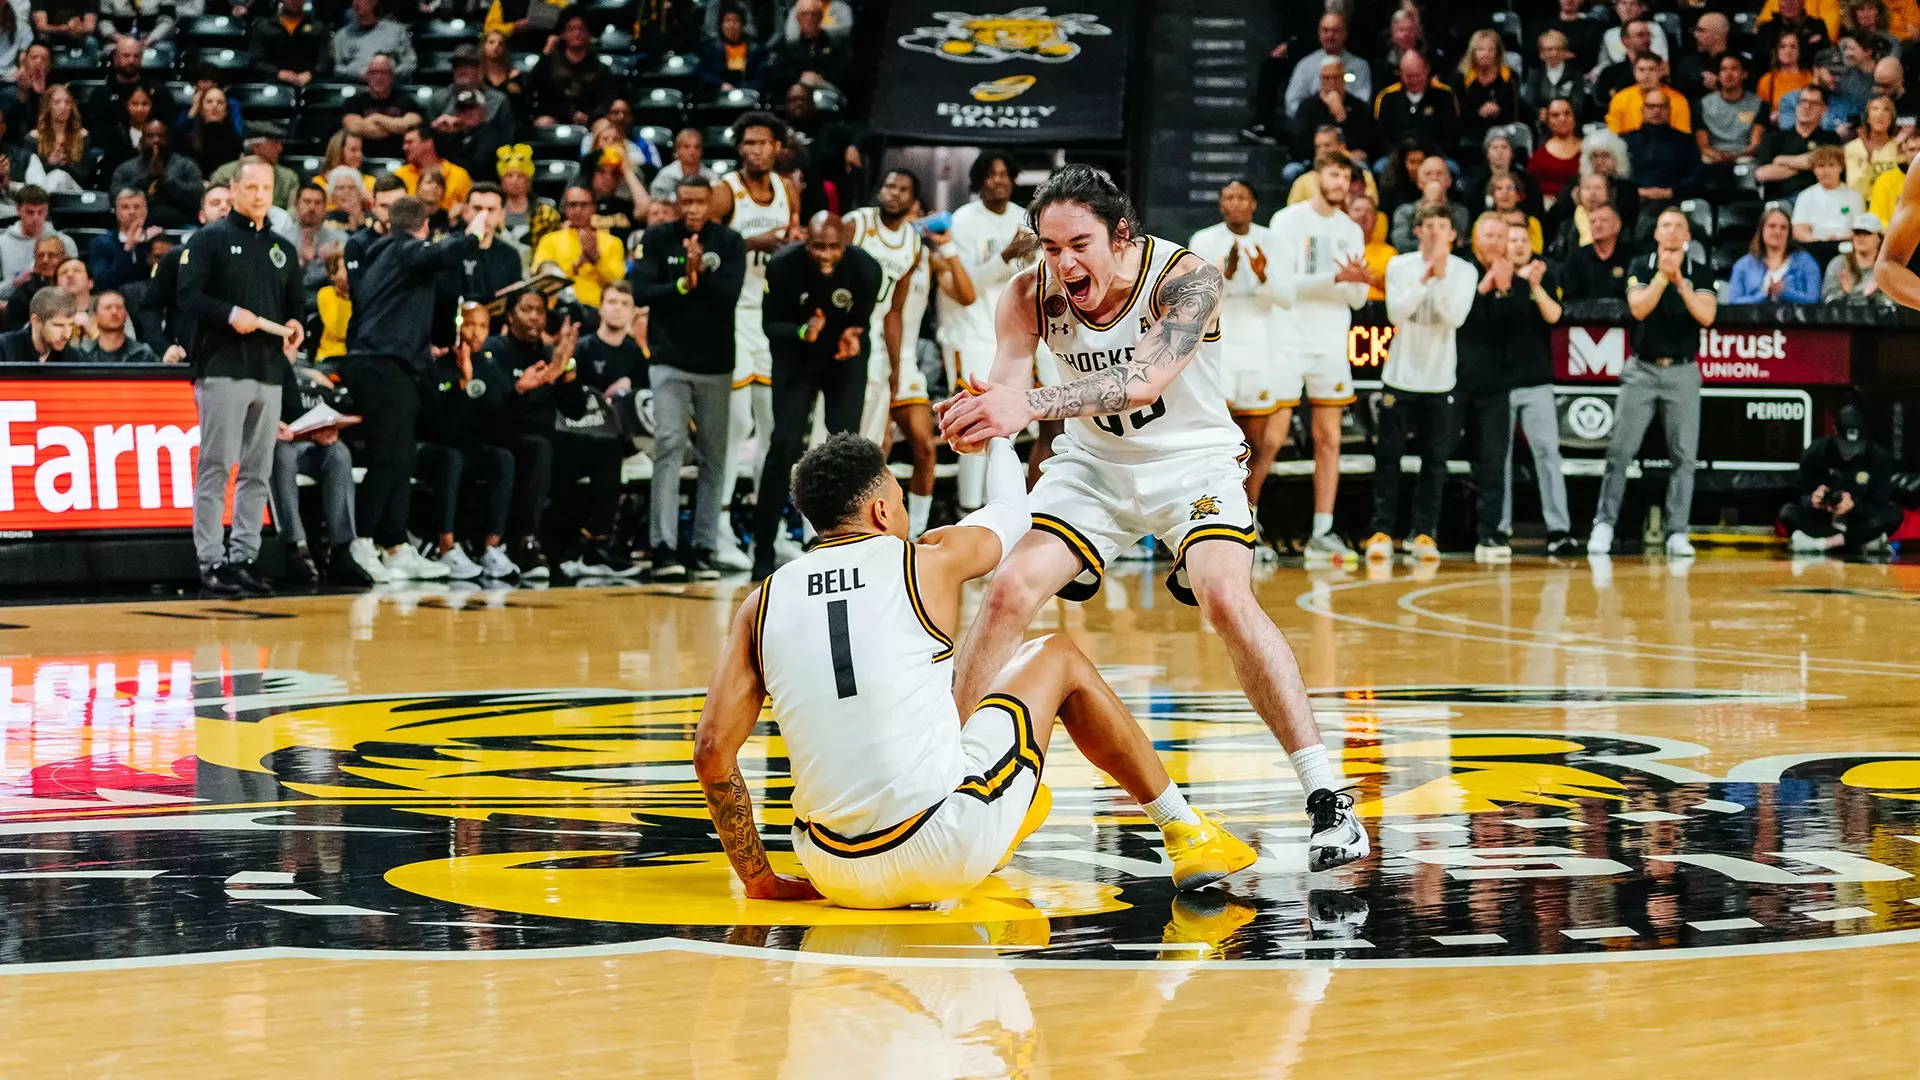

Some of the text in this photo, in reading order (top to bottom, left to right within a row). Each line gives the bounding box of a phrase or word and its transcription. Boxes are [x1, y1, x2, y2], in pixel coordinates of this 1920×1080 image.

[937, 102, 1057, 117] EQUITY
[951, 116, 1040, 128] BANK
[1348, 326, 1398, 367] CK
[1702, 362, 1759, 378] UNION
[1747, 401, 1804, 420] PERIOD
[0, 400, 200, 513] Farm
[808, 567, 866, 597] BELL
[827, 599, 858, 700] 1
